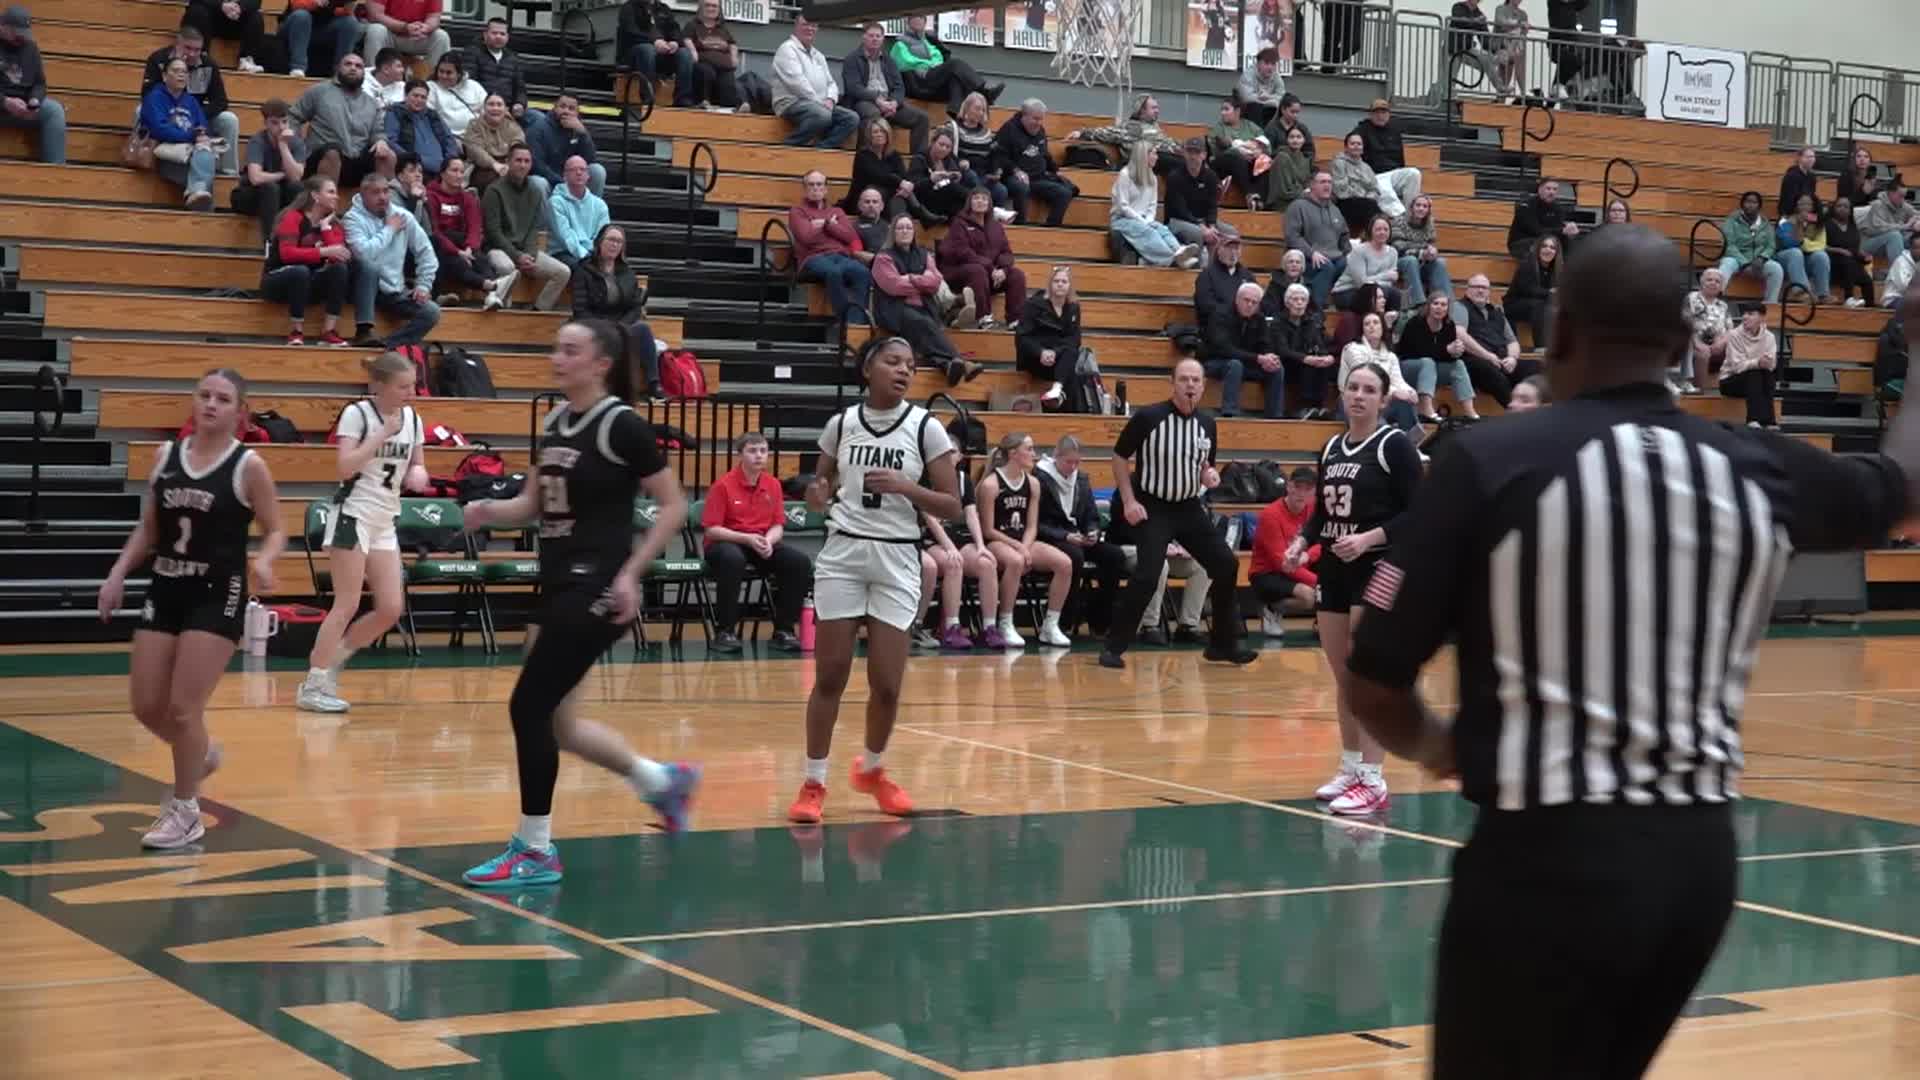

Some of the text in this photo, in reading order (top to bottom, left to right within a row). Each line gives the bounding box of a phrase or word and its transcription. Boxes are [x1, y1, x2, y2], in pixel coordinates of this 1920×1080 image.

[725, 0, 763, 20] OPHIA
[945, 23, 988, 43] JAYNIE
[1202, 49, 1223, 65] AVA
[848, 445, 905, 471] TITANS
[382, 463, 396, 490] 7
[1325, 462, 1362, 480] SOUTH
[1323, 484, 1353, 517] 23
